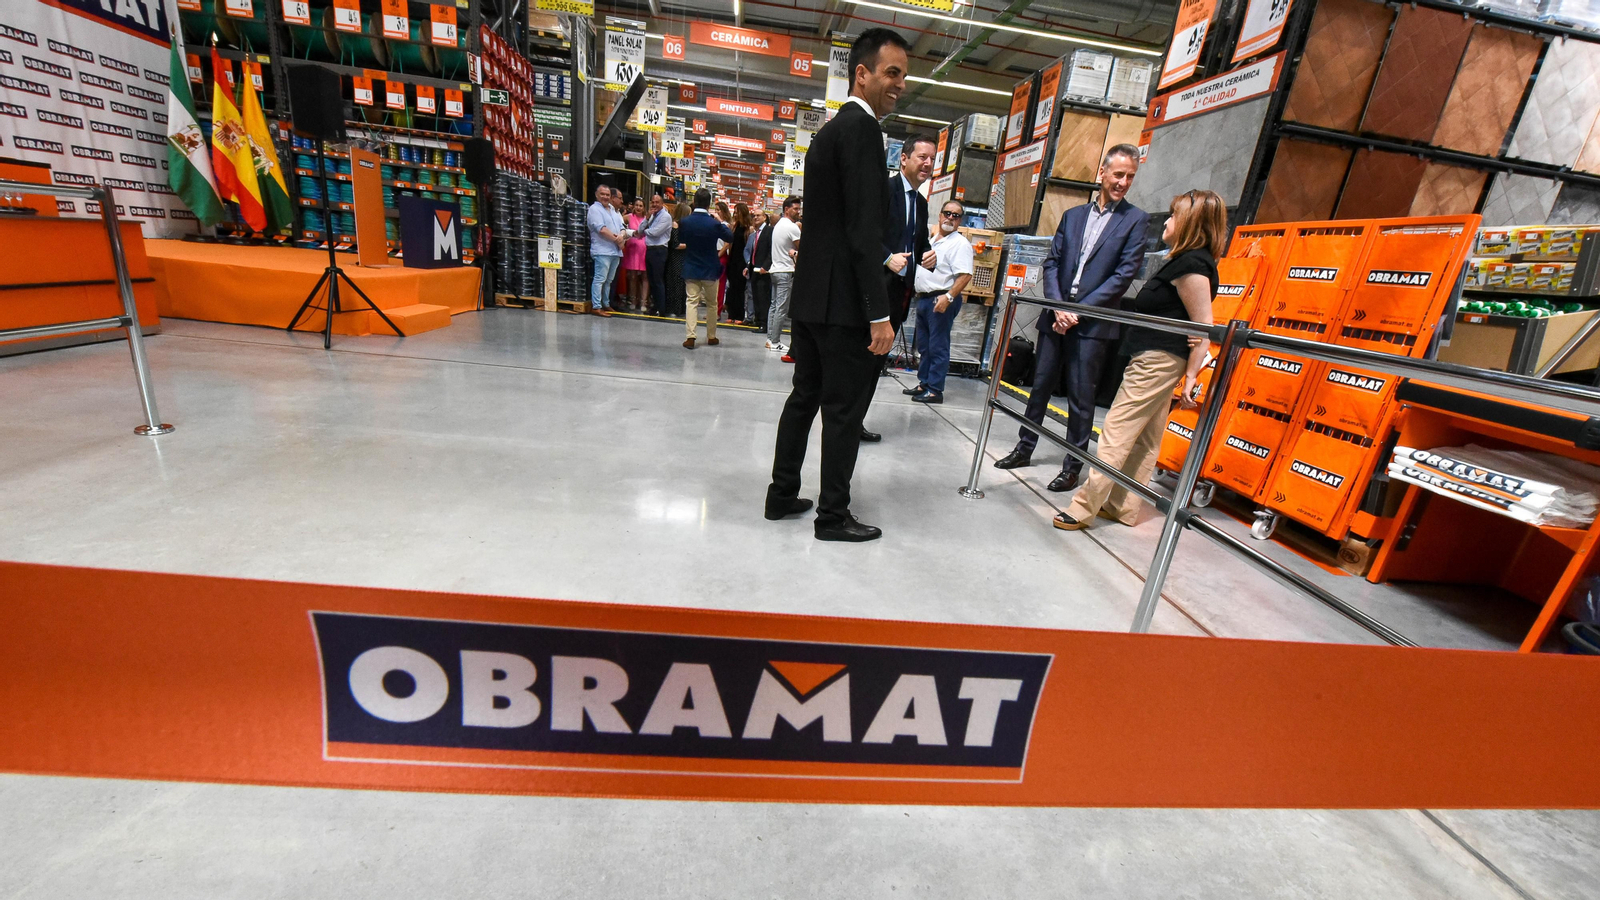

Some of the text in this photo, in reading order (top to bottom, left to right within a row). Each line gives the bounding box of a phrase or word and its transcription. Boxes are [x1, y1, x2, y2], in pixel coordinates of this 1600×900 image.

[0, 25, 36, 43] RAMAT
[608, 34, 642, 49] PANEL SOLAR
[710, 30, 769, 49] CERÁMICA
[50, 42, 94, 62] OBRAMAT
[666, 42, 682, 55] 06
[25, 58, 71, 78] OBRAMAT
[101, 57, 139, 75] OBRAMAT
[793, 59, 810, 71] 05
[81, 73, 122, 92] OBRAMAT
[145, 71, 170, 86] OBRAM
[1181, 68, 1260, 102] TODA NUESTRA CERÁMICA
[61, 91, 104, 108] OBRAMAT
[128, 87, 164, 103] OBRAMAT
[682, 89, 694, 99] 08
[1202, 88, 1238, 106] CALIDAD
[112, 103, 148, 119] OBRAMAT
[719, 103, 759, 115] PINTURA
[781, 105, 792, 115] 07
[39, 112, 82, 127] OBRAMAT
[695, 123, 704, 131] 10
[92, 122, 132, 137] OBRAMAT
[772, 132, 783, 141] 09
[15, 138, 63, 153] OBRAMAT
[137, 132, 168, 145] OBRAMA
[717, 137, 763, 149] HERRAMIENTAS
[73, 147, 113, 161] OBRAMAT
[121, 154, 156, 167] OBRAMAT
[55, 173, 94, 185] OBRAMAT
[104, 179, 144, 190] OBRAMAT
[434, 214, 459, 261] M
[1289, 268, 1336, 280] OBRAMAT
[1367, 272, 1431, 286] OBRAMAT
[1217, 286, 1244, 295] RAMAT
[1380, 319, 1413, 328] obramat.es
[1258, 356, 1301, 374] OBRAMAT
[1328, 371, 1383, 392] OBRAMAT
[1168, 422, 1193, 439] OBRAMA
[1227, 437, 1269, 459] OBRAMAT
[1292, 461, 1342, 487] OBRAMAT
[349, 644, 1023, 748] OBRAMAT
